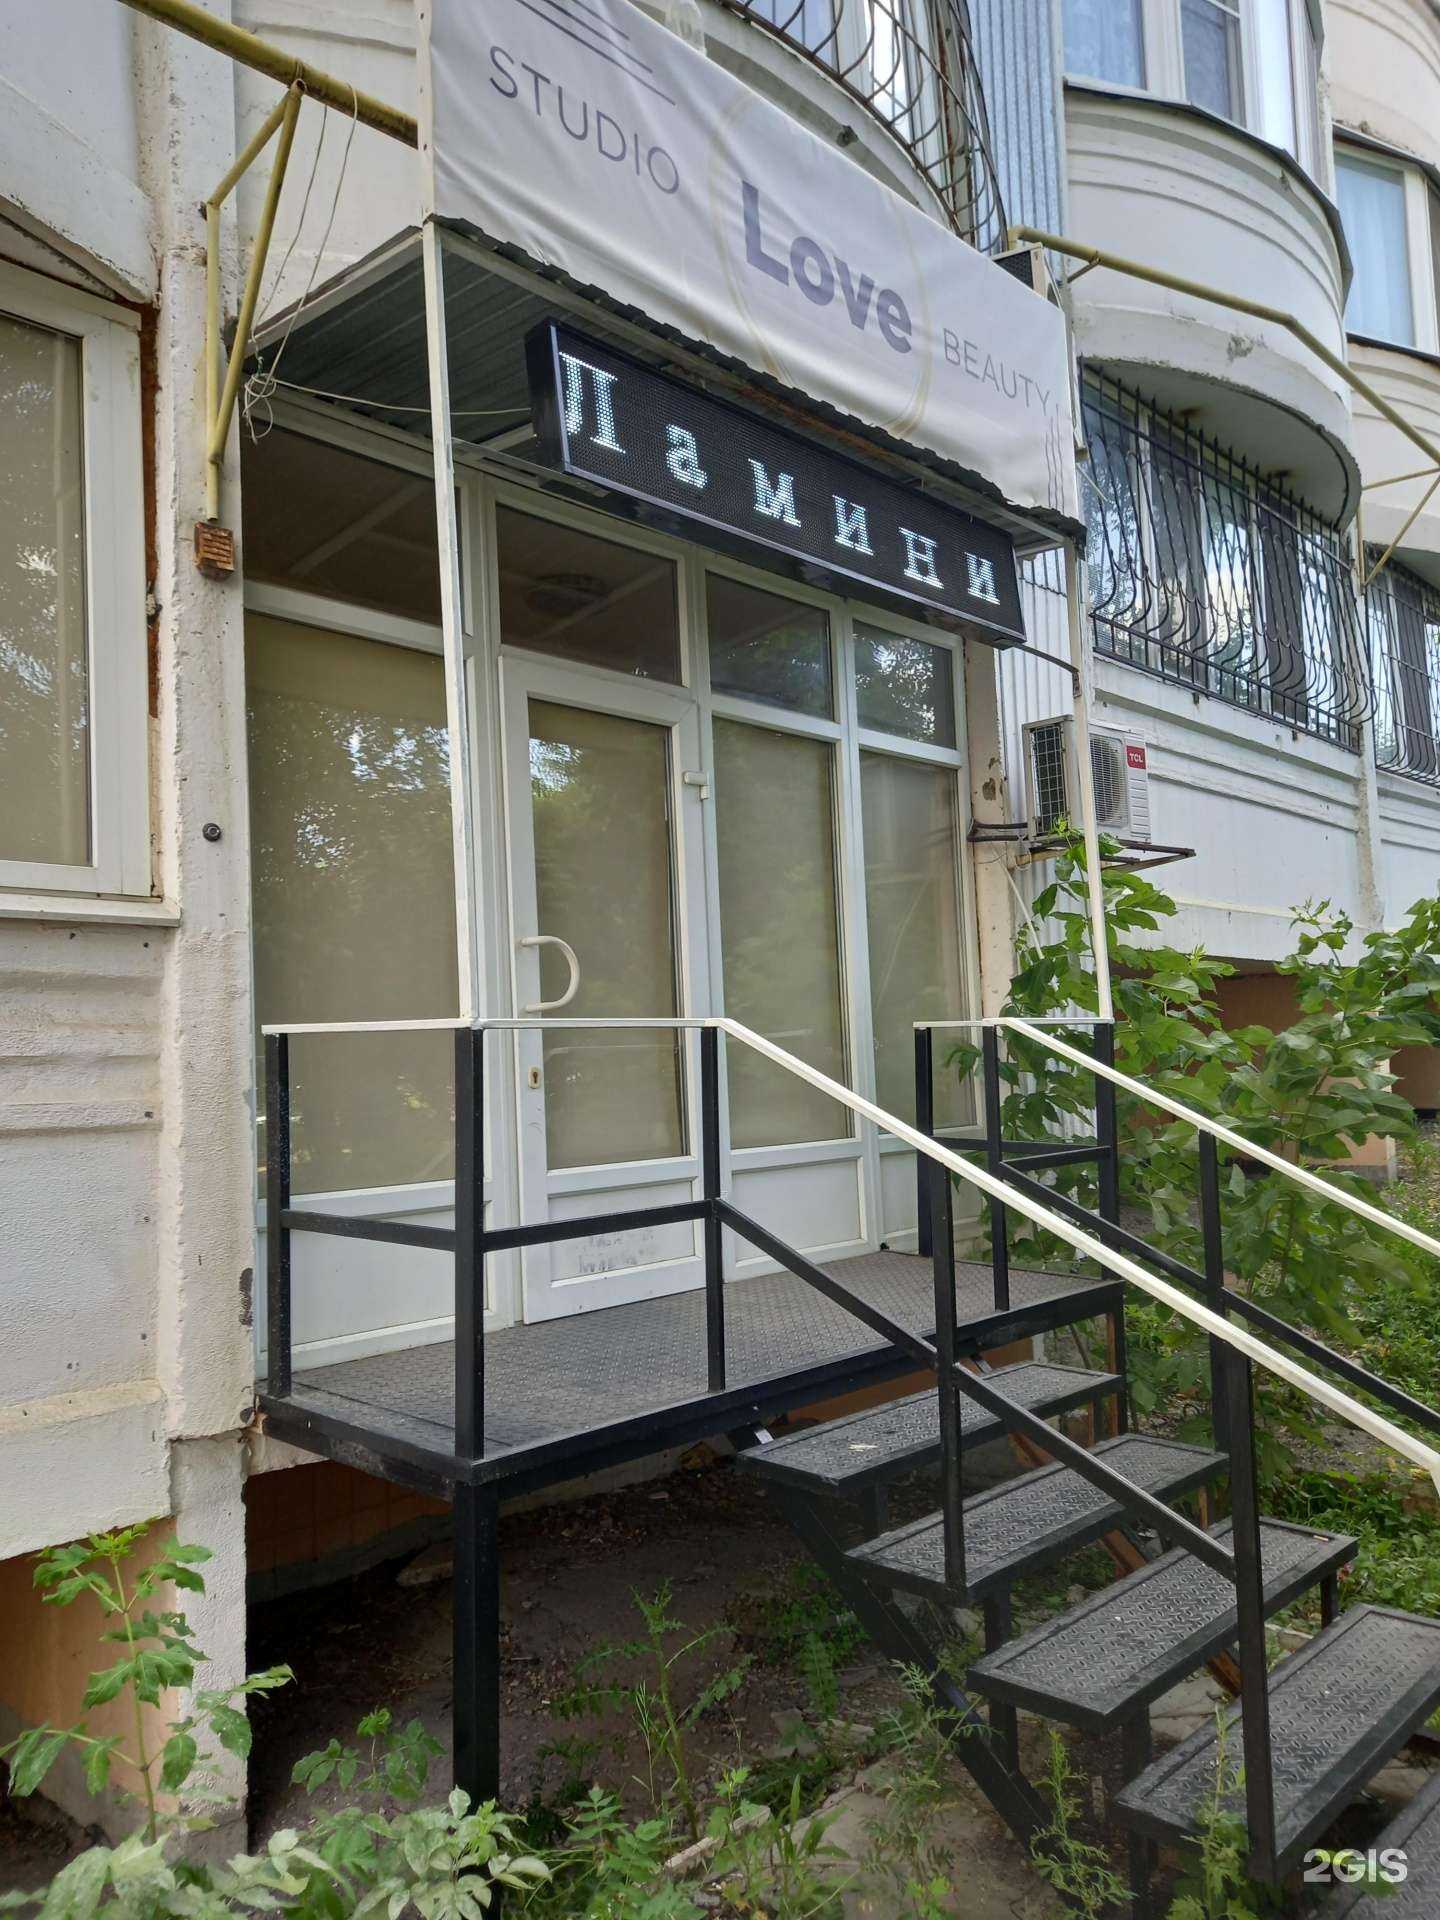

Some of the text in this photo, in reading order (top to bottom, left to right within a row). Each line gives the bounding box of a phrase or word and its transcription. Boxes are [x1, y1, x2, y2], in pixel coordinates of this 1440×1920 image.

[489, 45, 1049, 416] STUDIO Love BEAUTY
[1129, 752, 1143, 763] TCL
